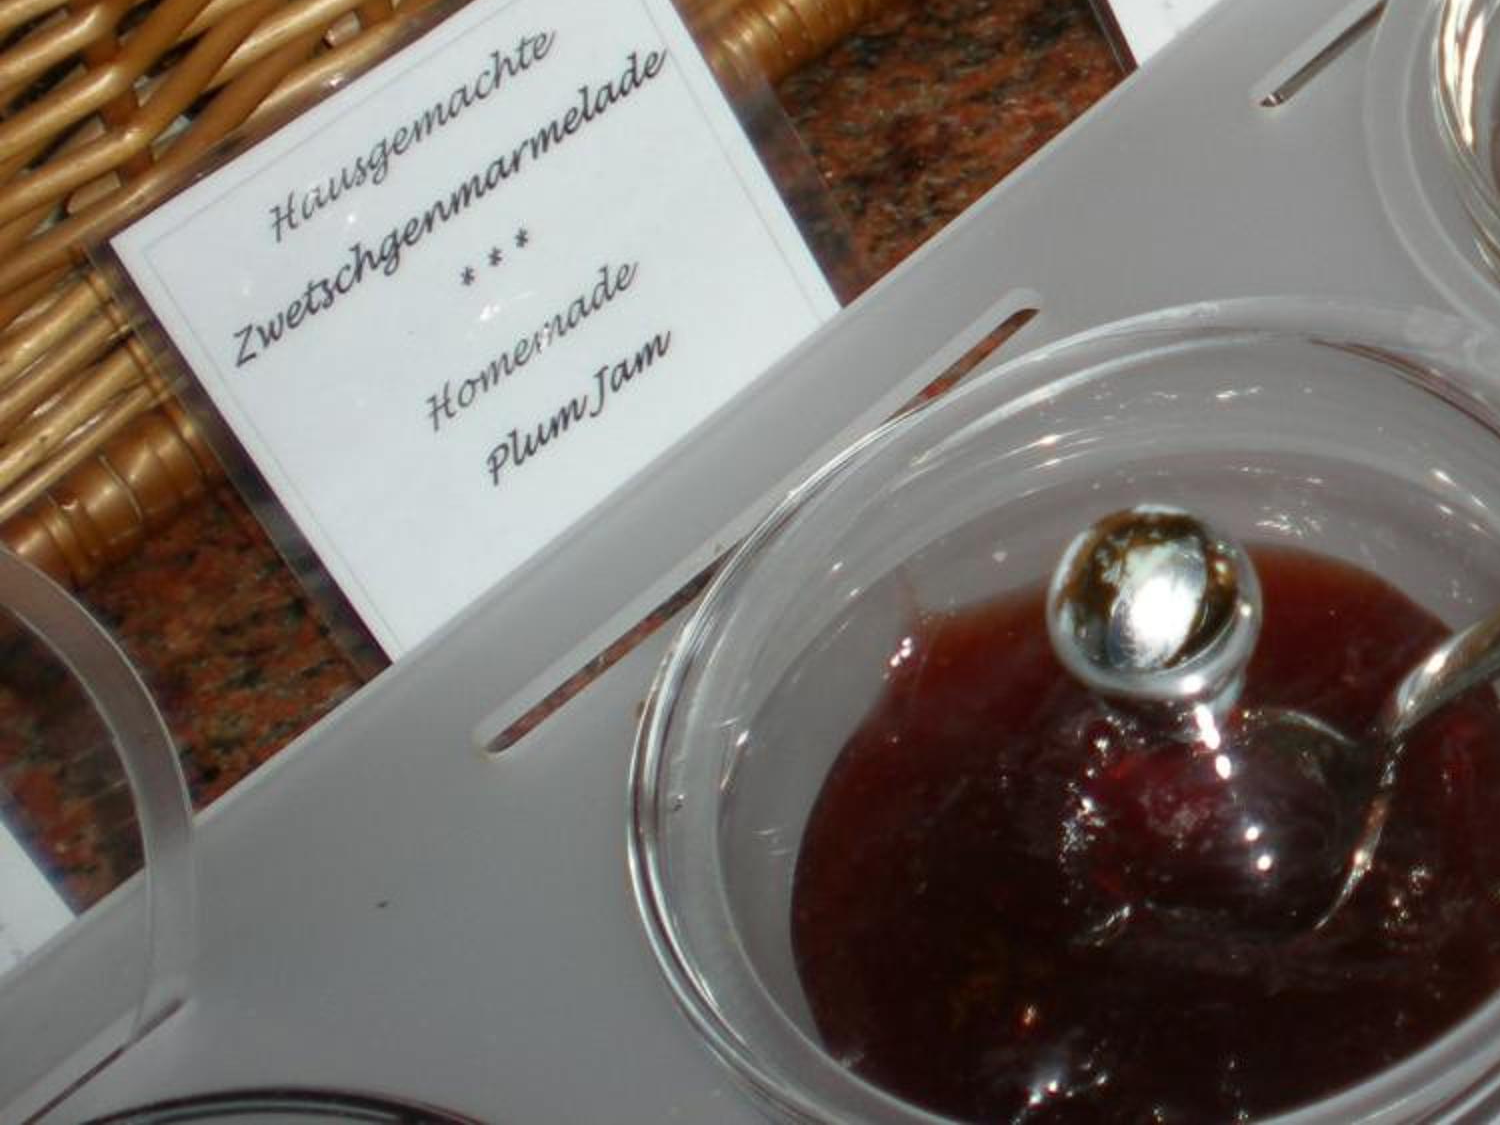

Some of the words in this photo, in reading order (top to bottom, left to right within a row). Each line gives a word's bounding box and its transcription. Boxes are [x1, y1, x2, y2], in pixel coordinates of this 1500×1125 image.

[232, 48, 668, 369] Zwetschgenmarmelade
[268, 31, 556, 244] Hausgemachte
[428, 262, 639, 433] Homemade
[485, 394, 589, 488] Plum
[586, 330, 672, 419] Jam
